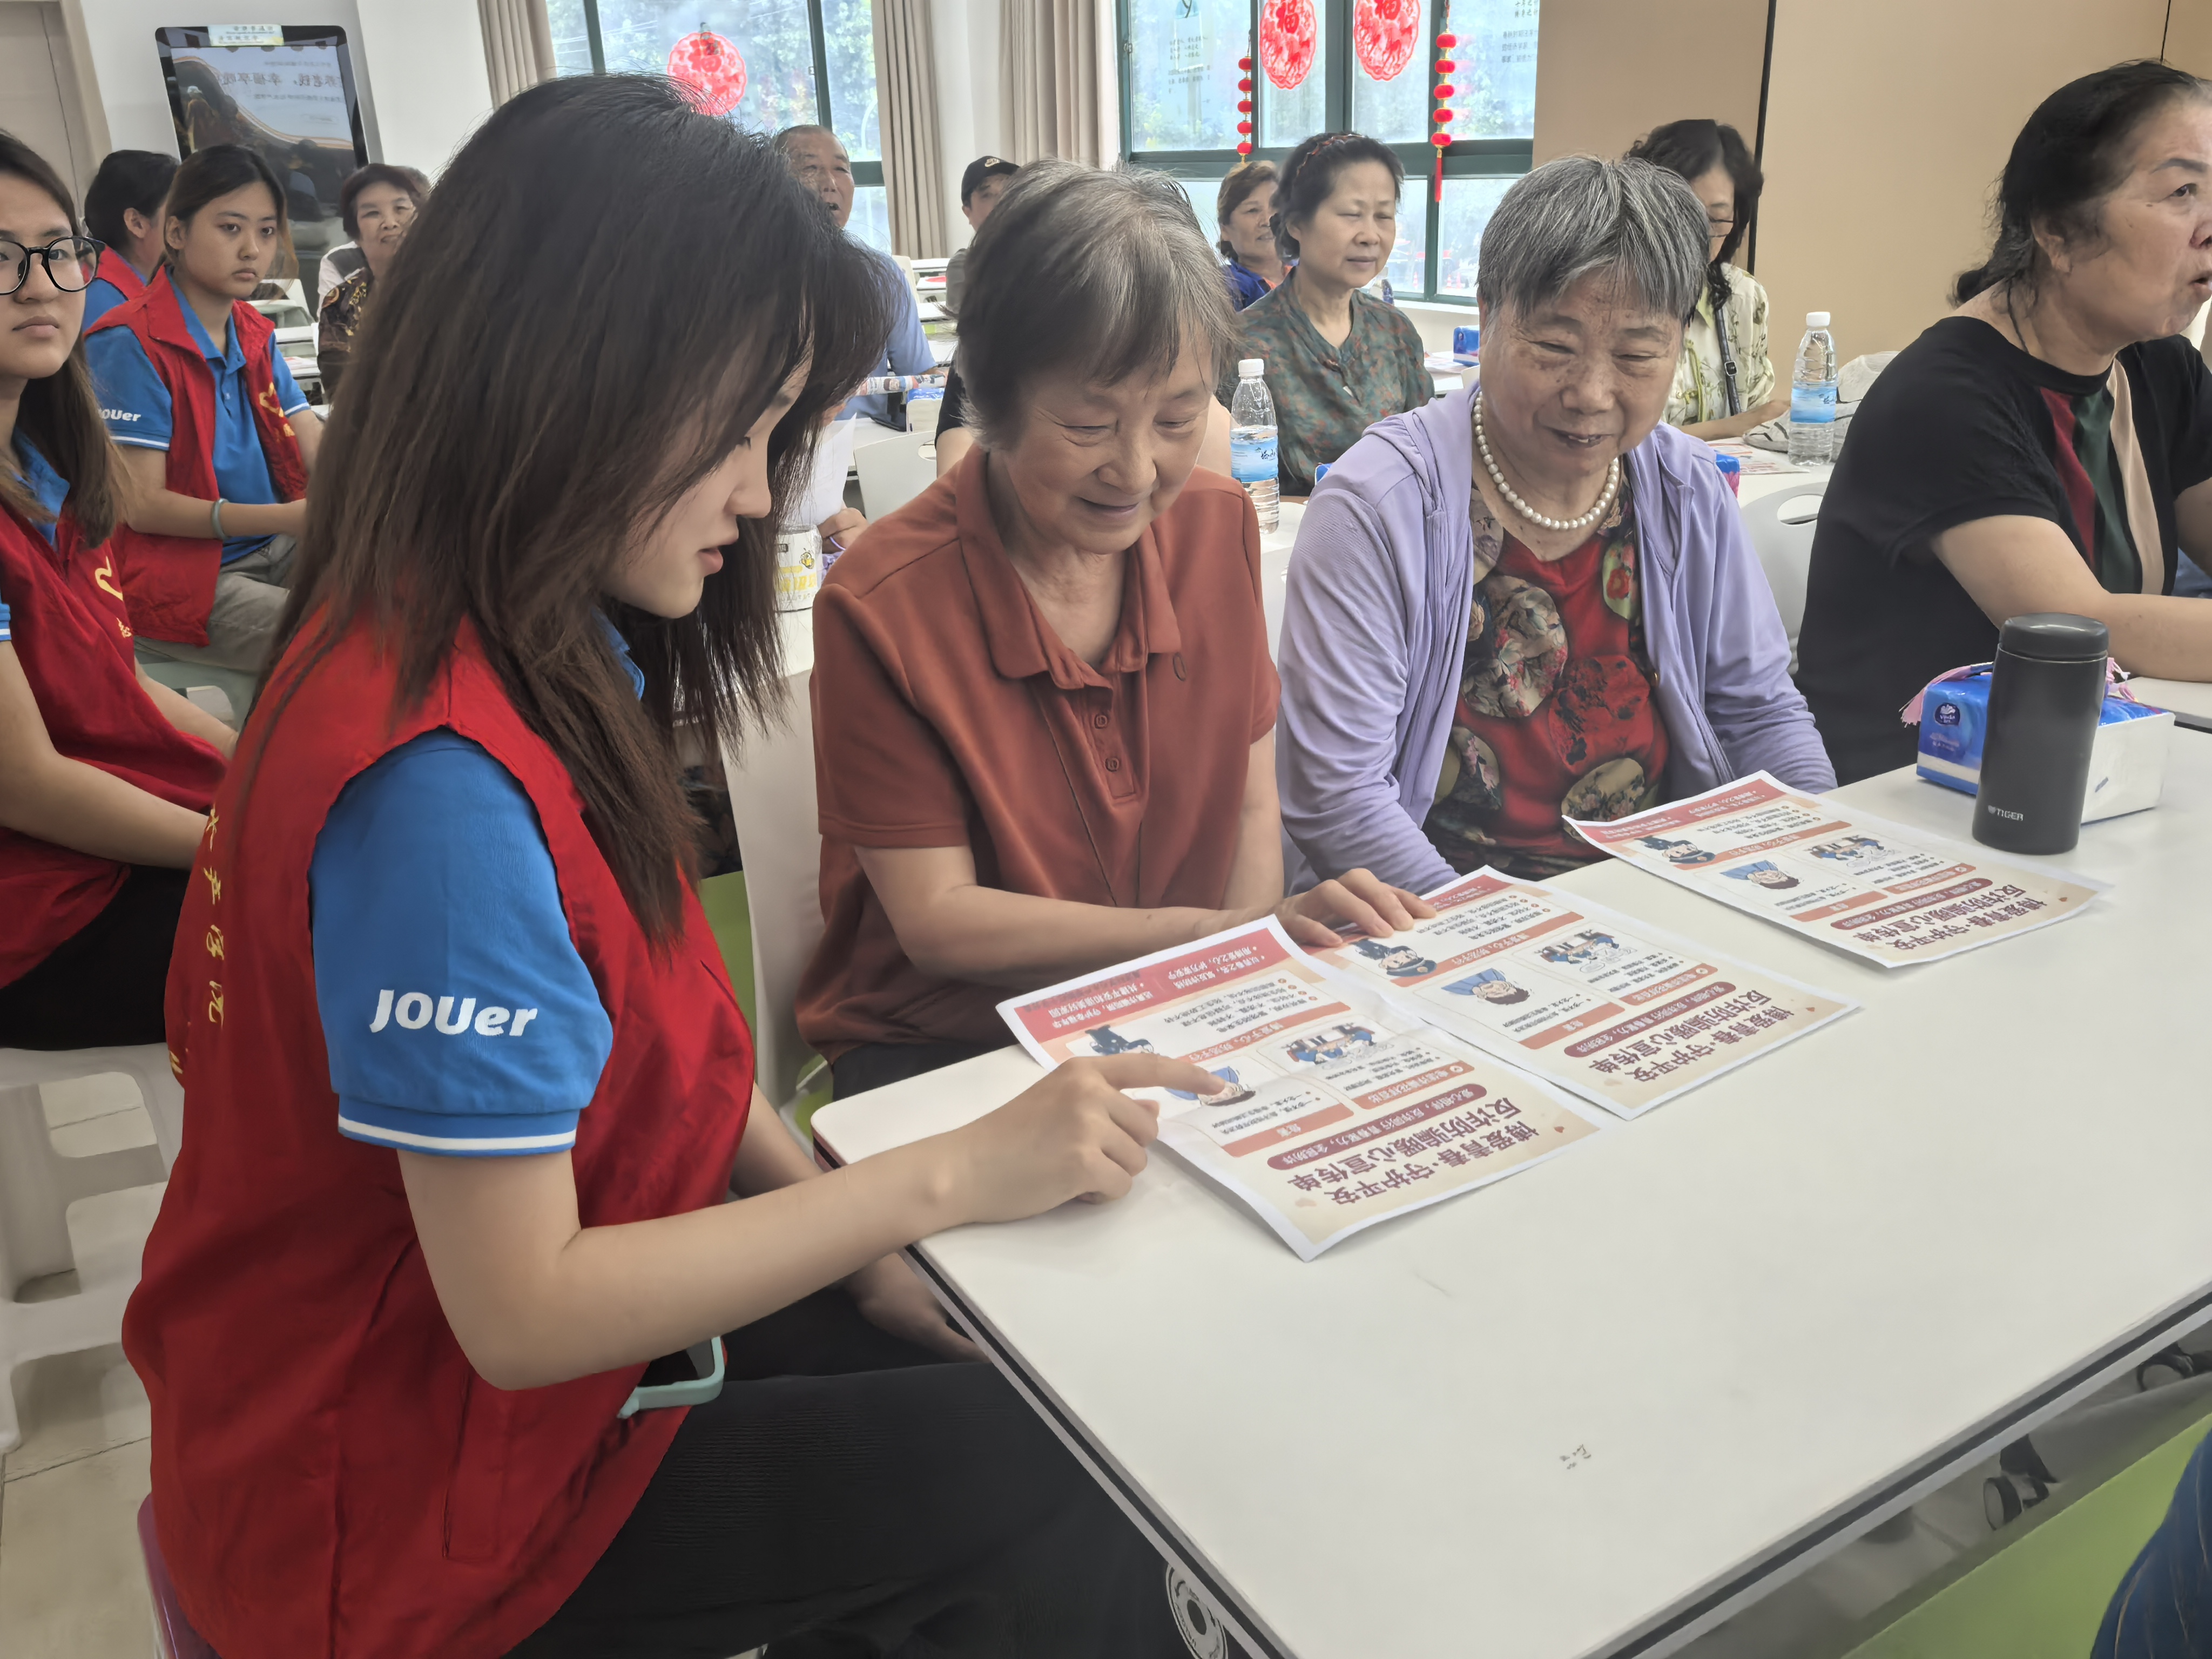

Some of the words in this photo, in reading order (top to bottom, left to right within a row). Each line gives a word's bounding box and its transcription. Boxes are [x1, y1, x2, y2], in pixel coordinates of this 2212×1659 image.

[99, 408, 141, 422] OUer
[1997, 808, 2024, 821] TIGER
[1853, 884, 2027, 943] 反诈防骗暖心宣传单
[1885, 897, 2048, 950] 博爱青春·守护平安
[369, 989, 537, 1037] JOUer
[1588, 989, 1772, 1074] 反诈防骗暖心宣传单
[1624, 1005, 1795, 1082] 博爱青春·守护平安
[1287, 1097, 1522, 1191] 反诈防骗暖心宣传单
[1324, 1120, 1540, 1205] 博爱青春·守护平安
